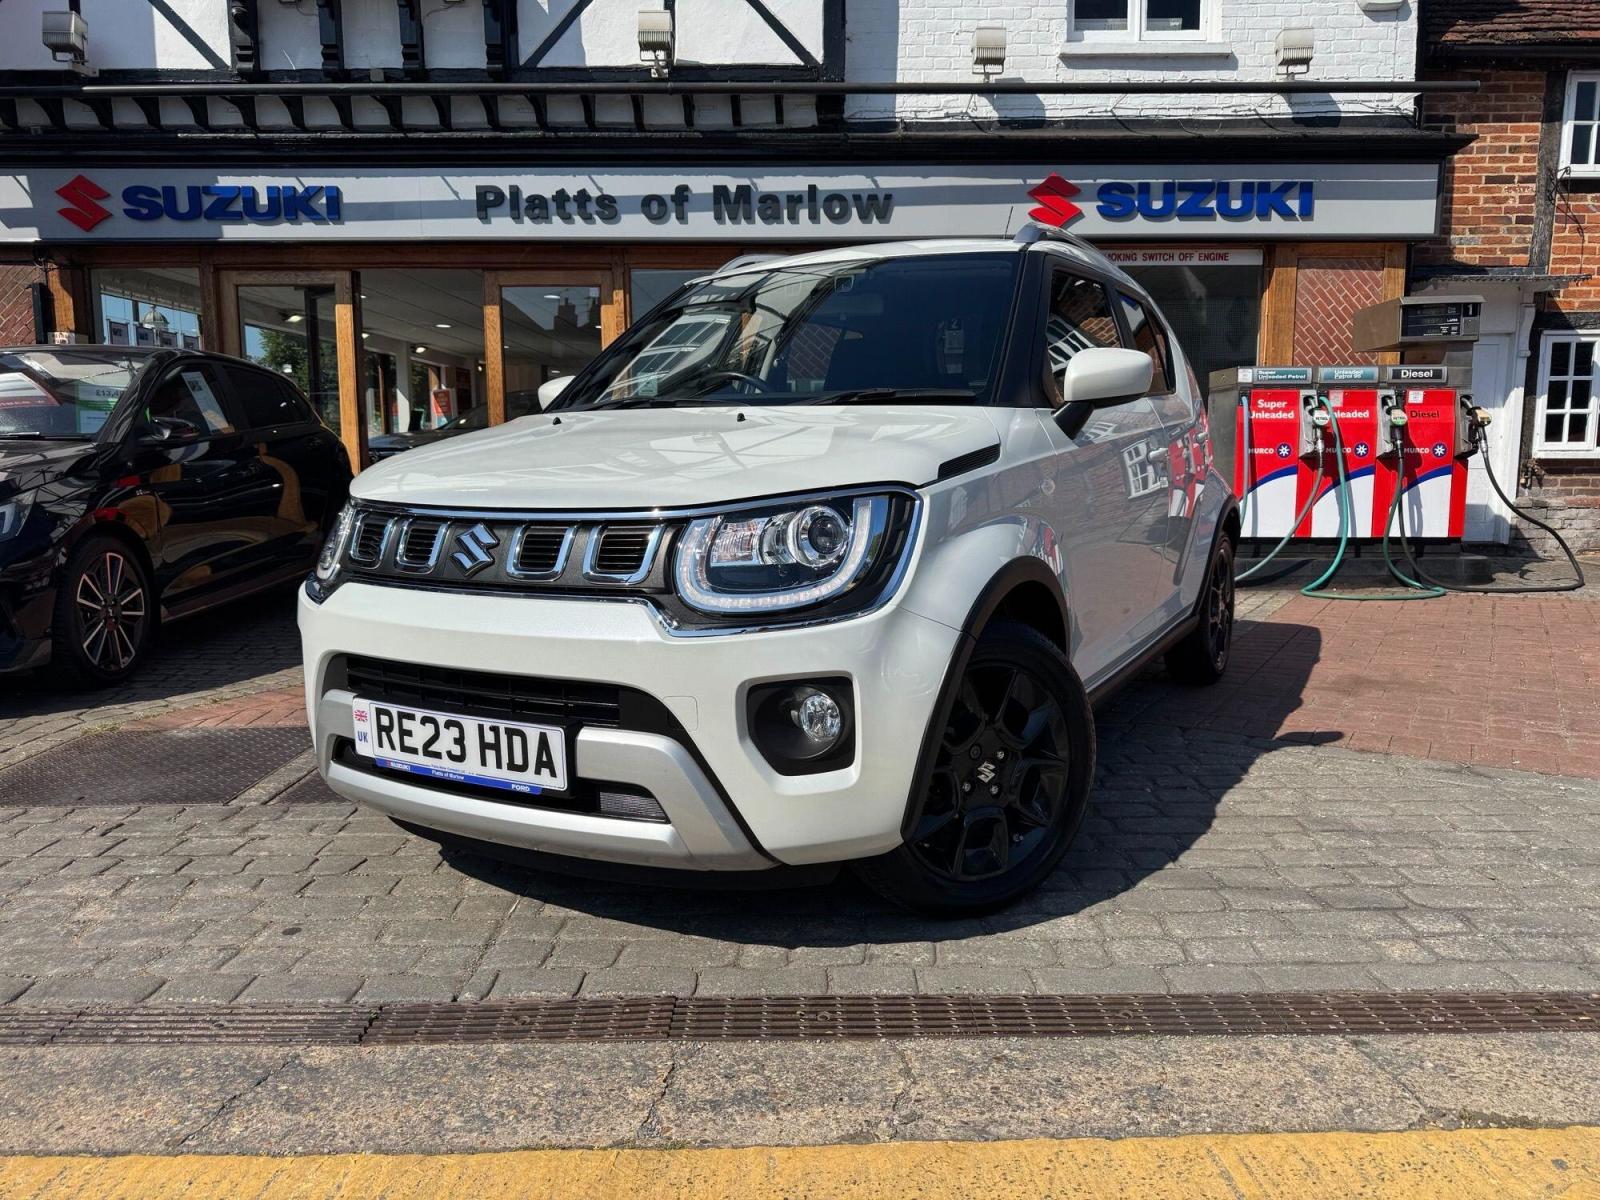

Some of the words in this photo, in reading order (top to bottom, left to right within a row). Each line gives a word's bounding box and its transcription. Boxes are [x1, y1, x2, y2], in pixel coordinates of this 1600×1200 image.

[122, 185, 342, 222] SUZUKI
[475, 184, 618, 222] Platts
[640, 184, 690, 221] of
[712, 184, 893, 222] Marlow
[1096, 181, 1314, 218] SUZUKI
[1104, 252, 1137, 262] MOKING
[1142, 252, 1175, 262] SWITCH
[1178, 252, 1194, 262] OFF
[1198, 252, 1230, 261] ENGINE
[1467, 304, 1473, 316] 1
[1401, 369, 1433, 378] Diesel
[1257, 399, 1287, 410] Super
[1410, 410, 1440, 418] Diesel
[357, 731, 369, 744] UK
[375, 706, 466, 763] RE23
[477, 722, 558, 778] HDA
[390, 761, 411, 772] SUZUKI
[511, 783, 530, 792] FORD
